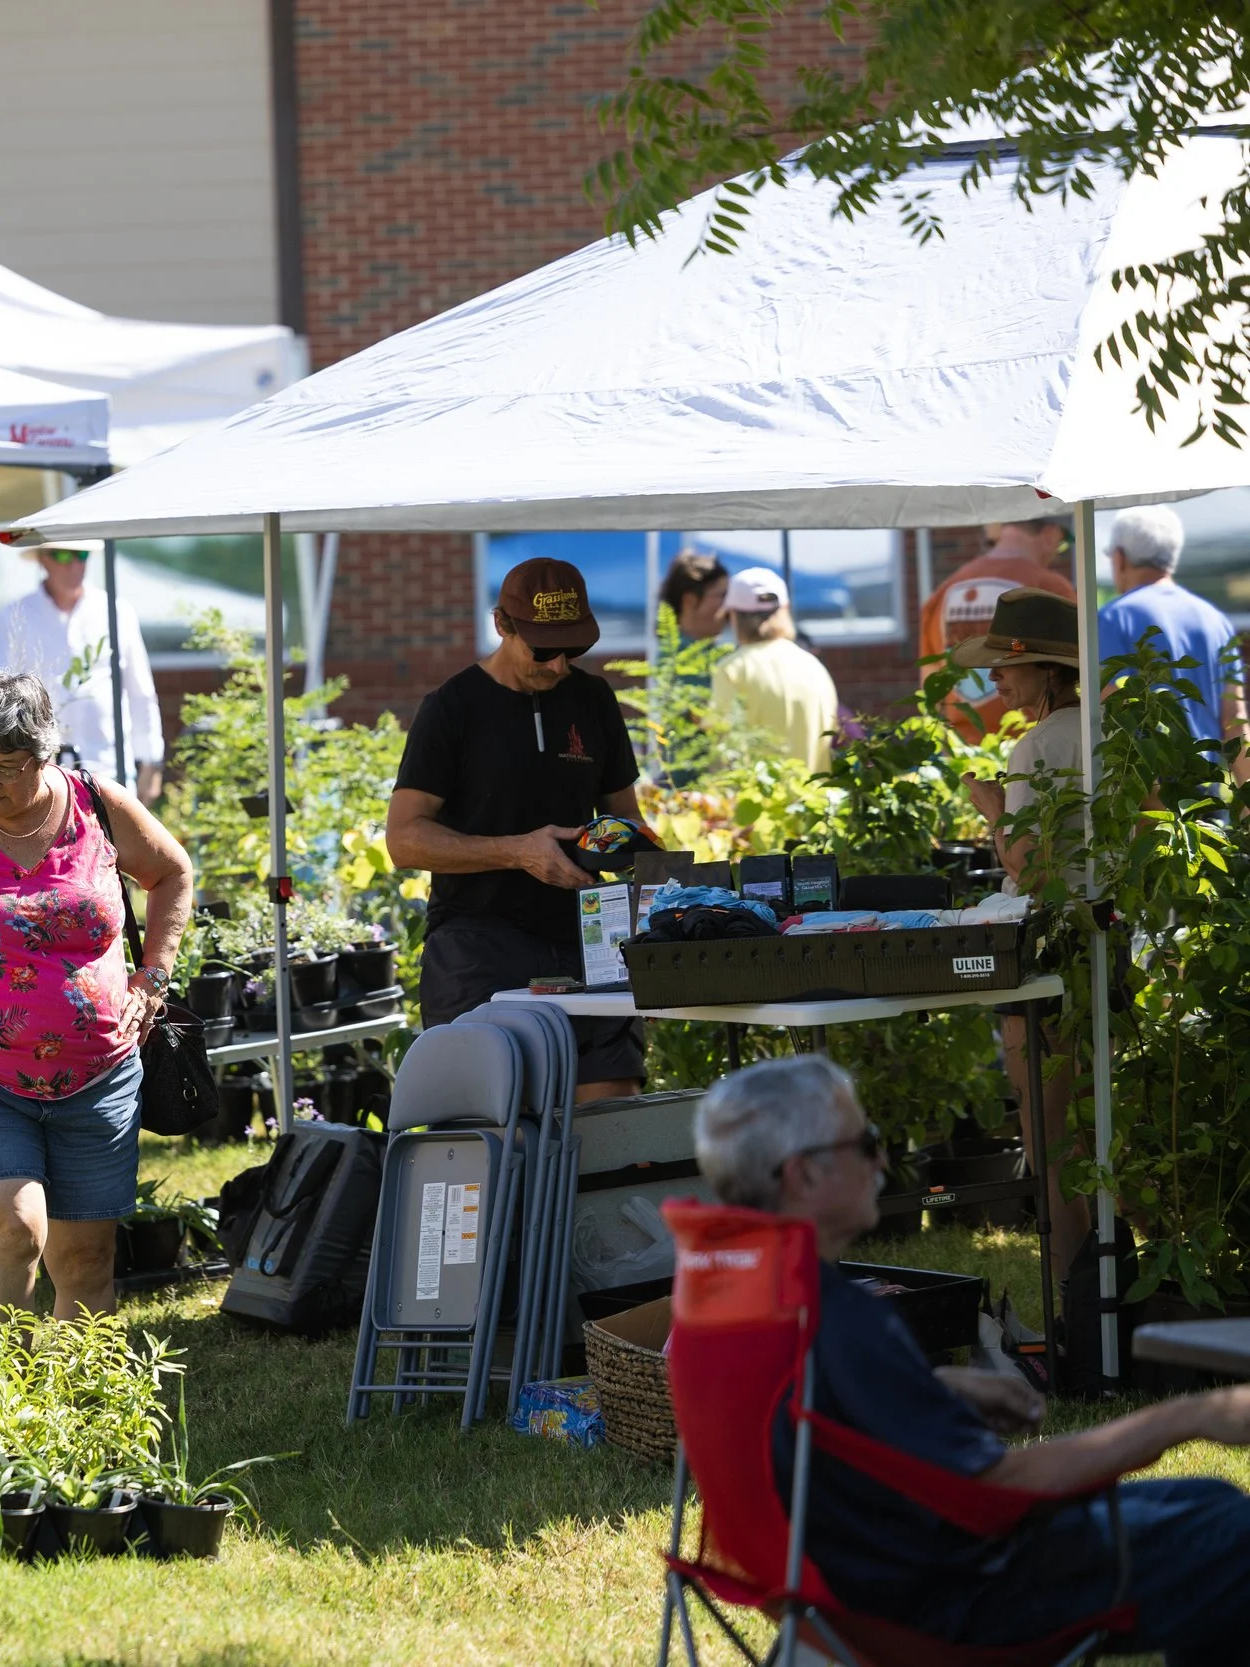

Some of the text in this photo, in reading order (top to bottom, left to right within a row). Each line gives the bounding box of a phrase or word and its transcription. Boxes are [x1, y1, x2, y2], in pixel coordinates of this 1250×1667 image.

[533, 588, 578, 607] Grasslands
[955, 958, 992, 971] ULINE
[925, 1195, 952, 1204] LIFETIME
